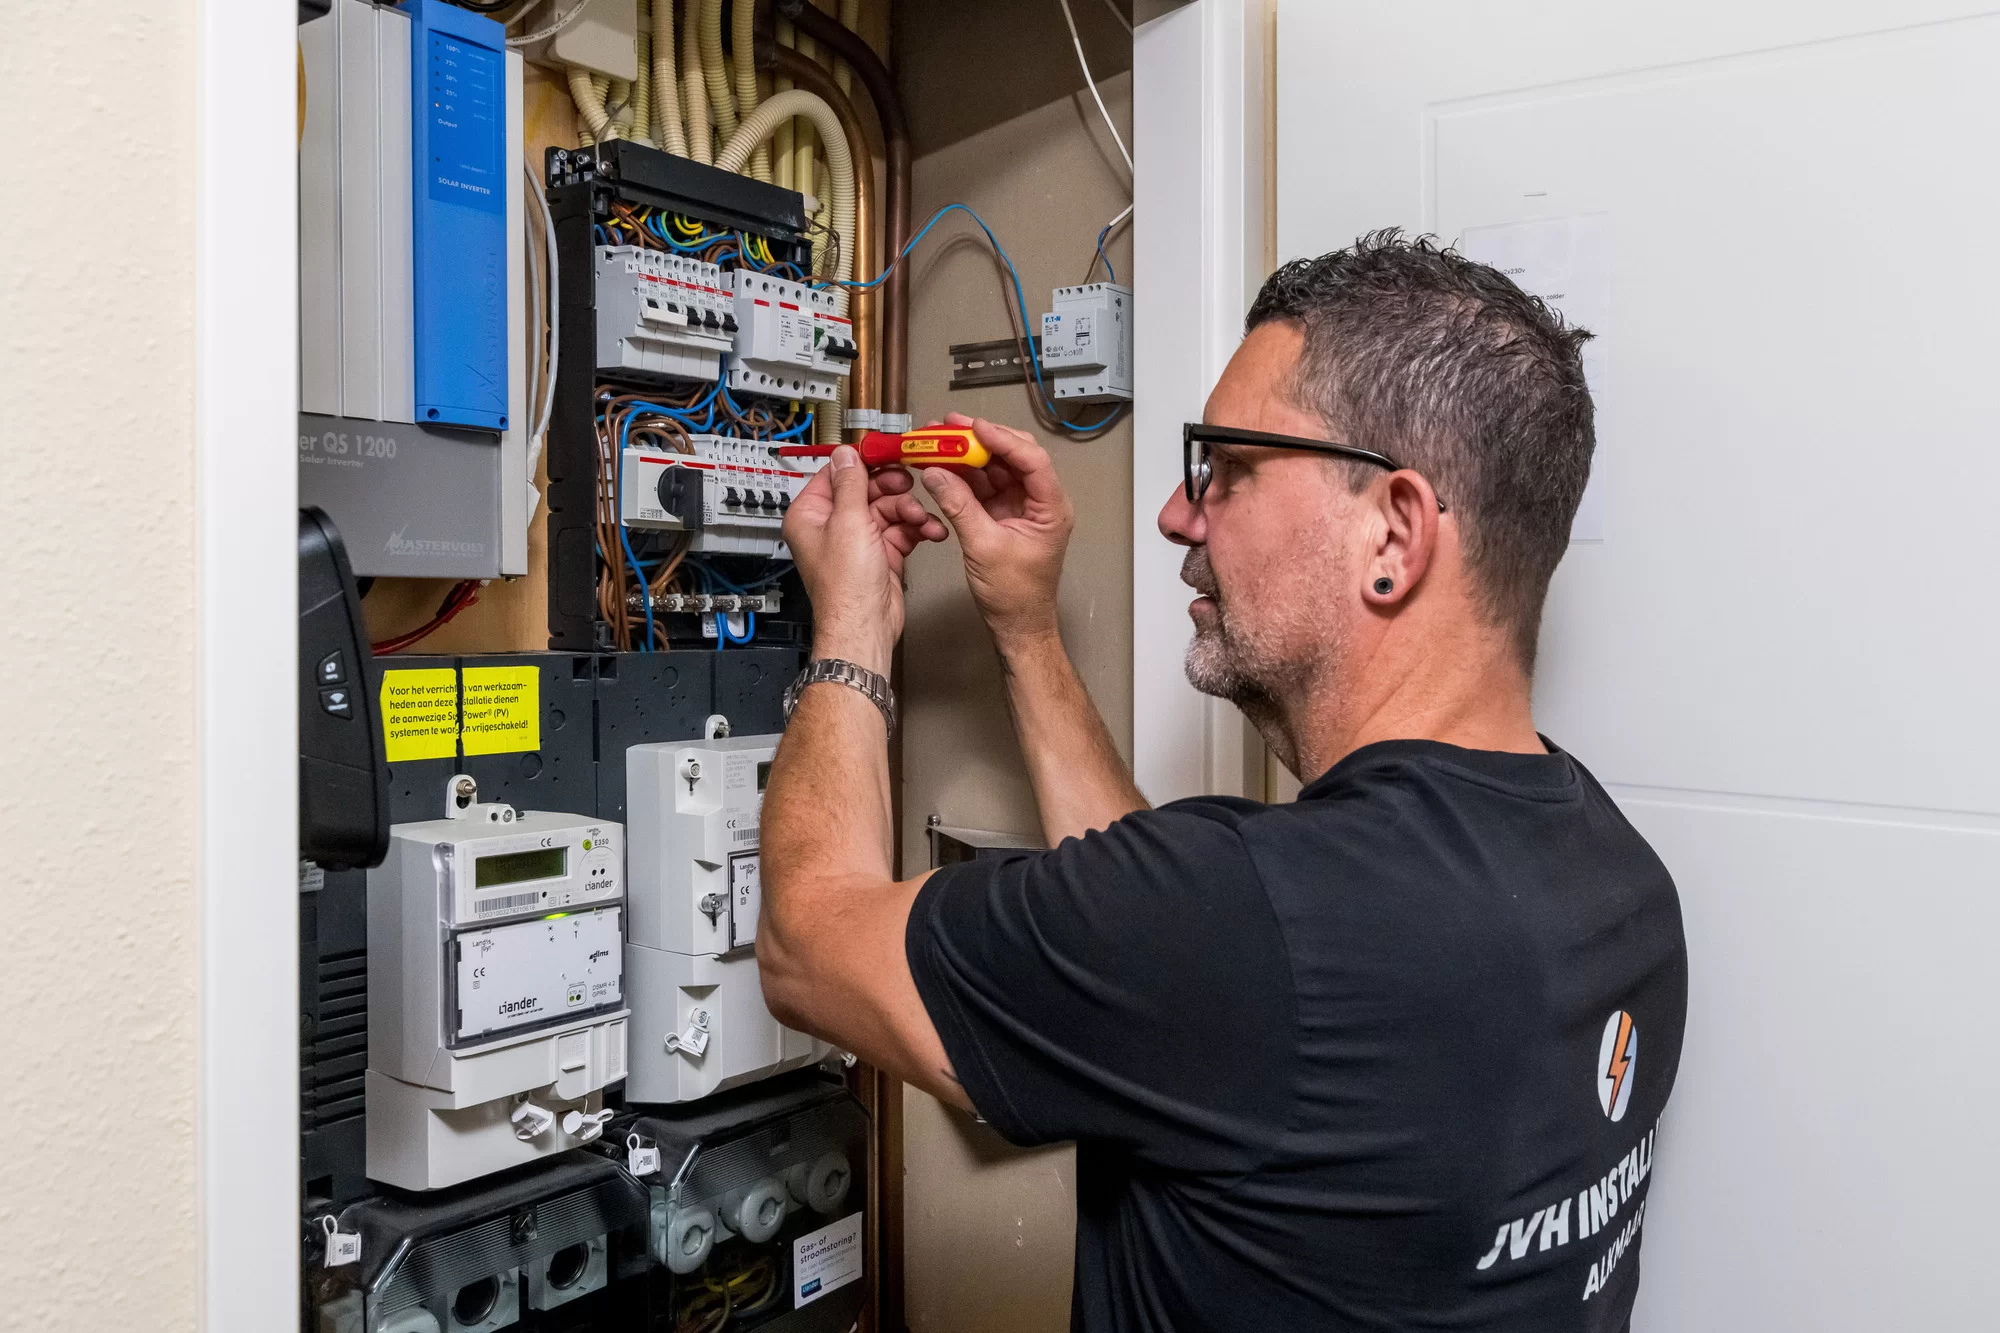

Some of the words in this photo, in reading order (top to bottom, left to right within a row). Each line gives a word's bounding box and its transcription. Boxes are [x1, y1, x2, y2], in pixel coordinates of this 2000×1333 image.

[445, 44, 461, 54] 100%
[445, 74, 458, 83] 50%
[438, 118, 458, 129] Output
[438, 176, 460, 188] SOLAR
[460, 182, 491, 196] INVERTER
[323, 431, 349, 454] QS
[355, 434, 397, 459] 1200
[299, 454, 326, 464] Solar
[327, 456, 365, 468] Inverter
[708, 452, 714, 460] N
[389, 686, 410, 696] Voor
[411, 685, 425, 695] het
[468, 684, 483, 692] van
[484, 682, 528, 691] werkzaam-
[389, 700, 416, 710] heden
[417, 700, 433, 708] aan
[434, 698, 454, 707] deze
[494, 694, 519, 704] dienen
[389, 715, 401, 724] de
[402, 712, 447, 723] aanwezige
[493, 708, 510, 719] (PV)
[390, 728, 430, 740] systemen
[431, 726, 439, 735] te
[472, 719, 529, 733] vrijgeschakeld!
[594, 838, 610, 847] E350
[585, 879, 614, 892] Liander
[498, 996, 538, 1015] Liander
[1476, 1197, 1573, 1271] JVH
[800, 1243, 817, 1254] Gas-
[818, 1235, 827, 1246] of
[800, 1232, 857, 1265] stroomstoring?
